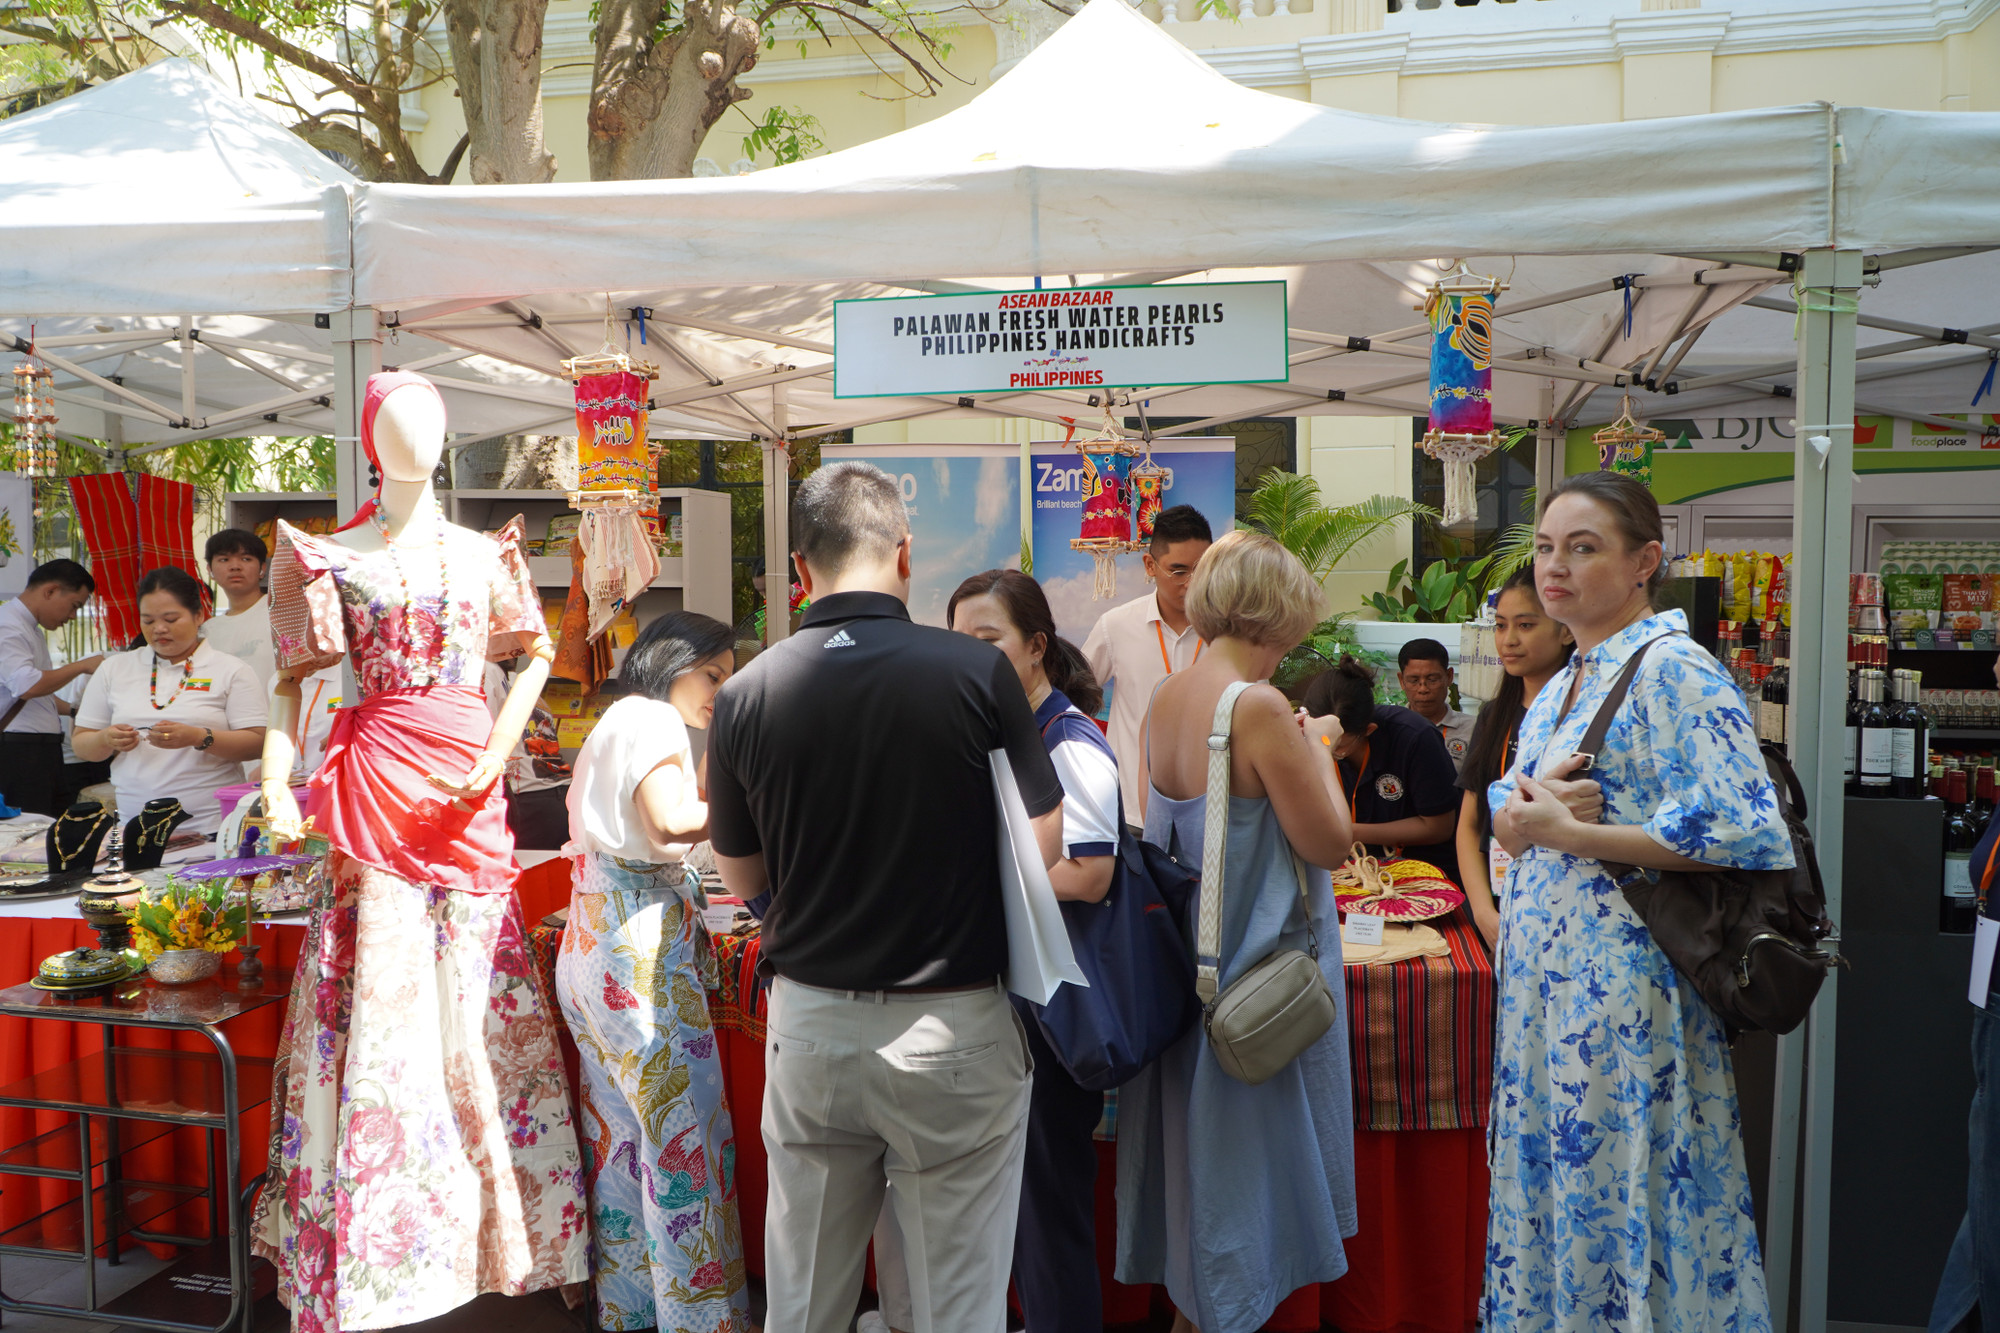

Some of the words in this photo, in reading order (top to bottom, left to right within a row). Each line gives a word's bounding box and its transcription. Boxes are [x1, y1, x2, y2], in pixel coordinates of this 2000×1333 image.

[998, 292, 1048, 309] ASEAN
[1050, 290, 1113, 307] BAZAAR
[893, 311, 990, 337] PALAWAN
[1000, 309, 1059, 331] FRESH
[1068, 306, 1140, 329] WATER
[1149, 303, 1225, 325] PEARLS
[921, 331, 1047, 356] PHILIPPINES
[1056, 326, 1196, 350] HANDICRAFTS
[1010, 369, 1103, 388] PHILIPPINES
[1911, 437, 1967, 448] foodplace
[1036, 500, 1060, 509] Brilliant
[823, 639, 856, 649] adidas
